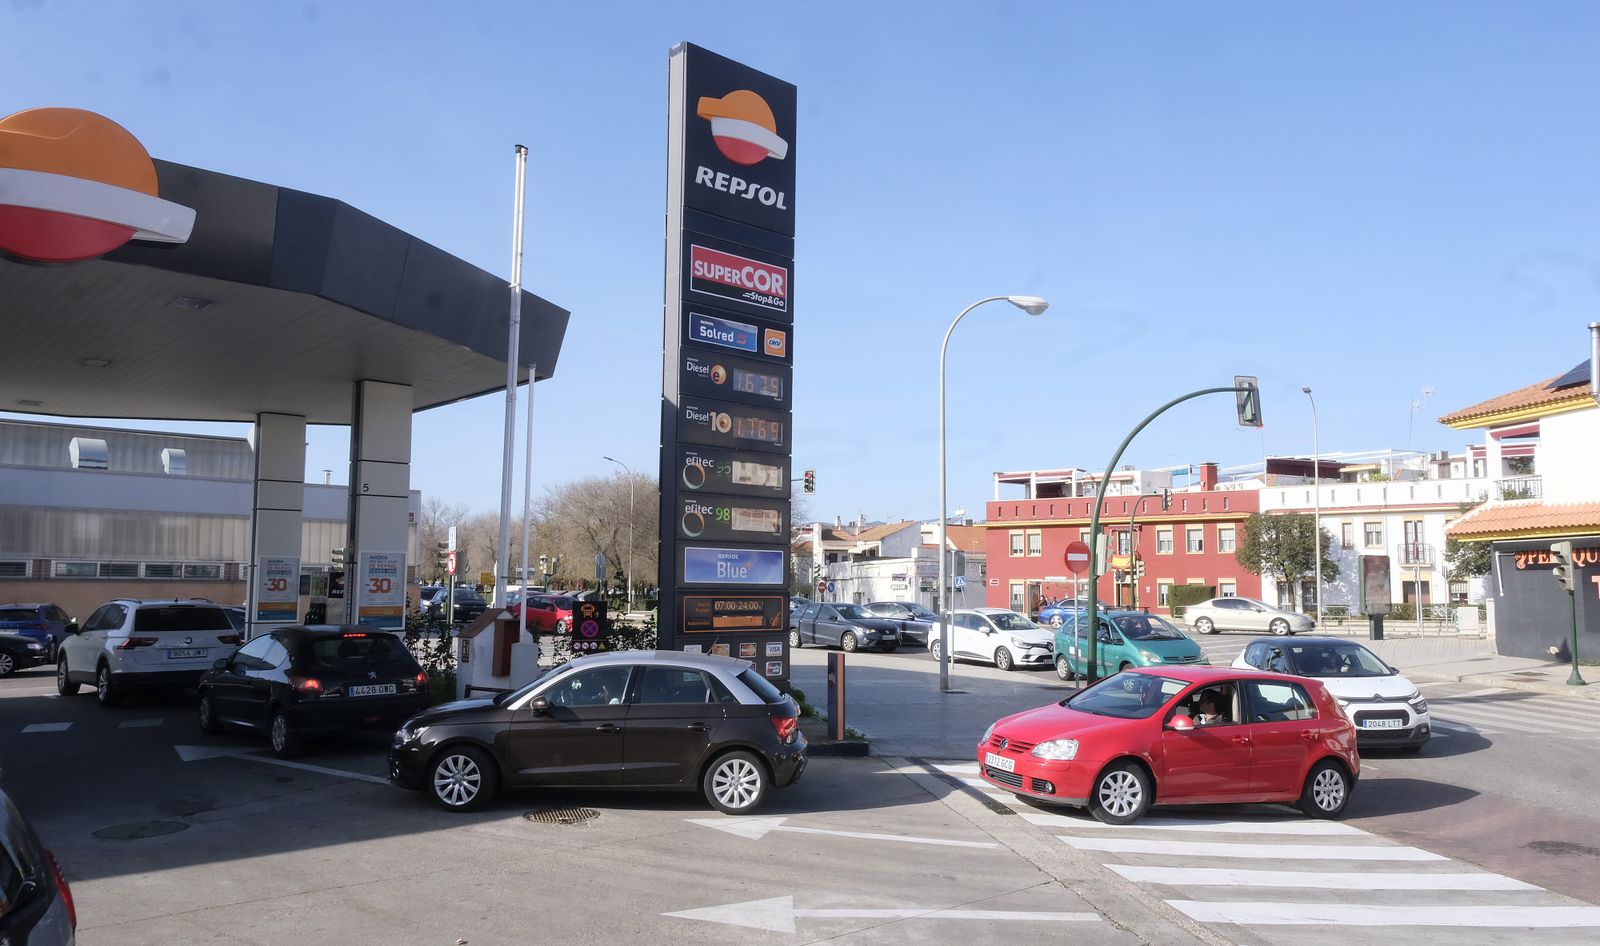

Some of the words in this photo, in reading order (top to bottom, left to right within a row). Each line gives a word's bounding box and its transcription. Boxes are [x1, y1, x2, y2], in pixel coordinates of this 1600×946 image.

[695, 166, 787, 210] REPSOL
[694, 260, 784, 295] SUPERCOR
[750, 292, 784, 307] Stop&Go
[700, 326, 734, 342] Solred
[686, 361, 709, 374] Diesel
[686, 410, 709, 421] Diesel
[710, 411, 732, 433] 10
[685, 456, 714, 468] efitec
[363, 483, 369, 492] 5
[685, 504, 713, 515] efitec
[715, 507, 730, 521] 98
[717, 562, 747, 578] Blue
[355, 686, 377, 695] 4428
[1368, 720, 1386, 728] 2048
